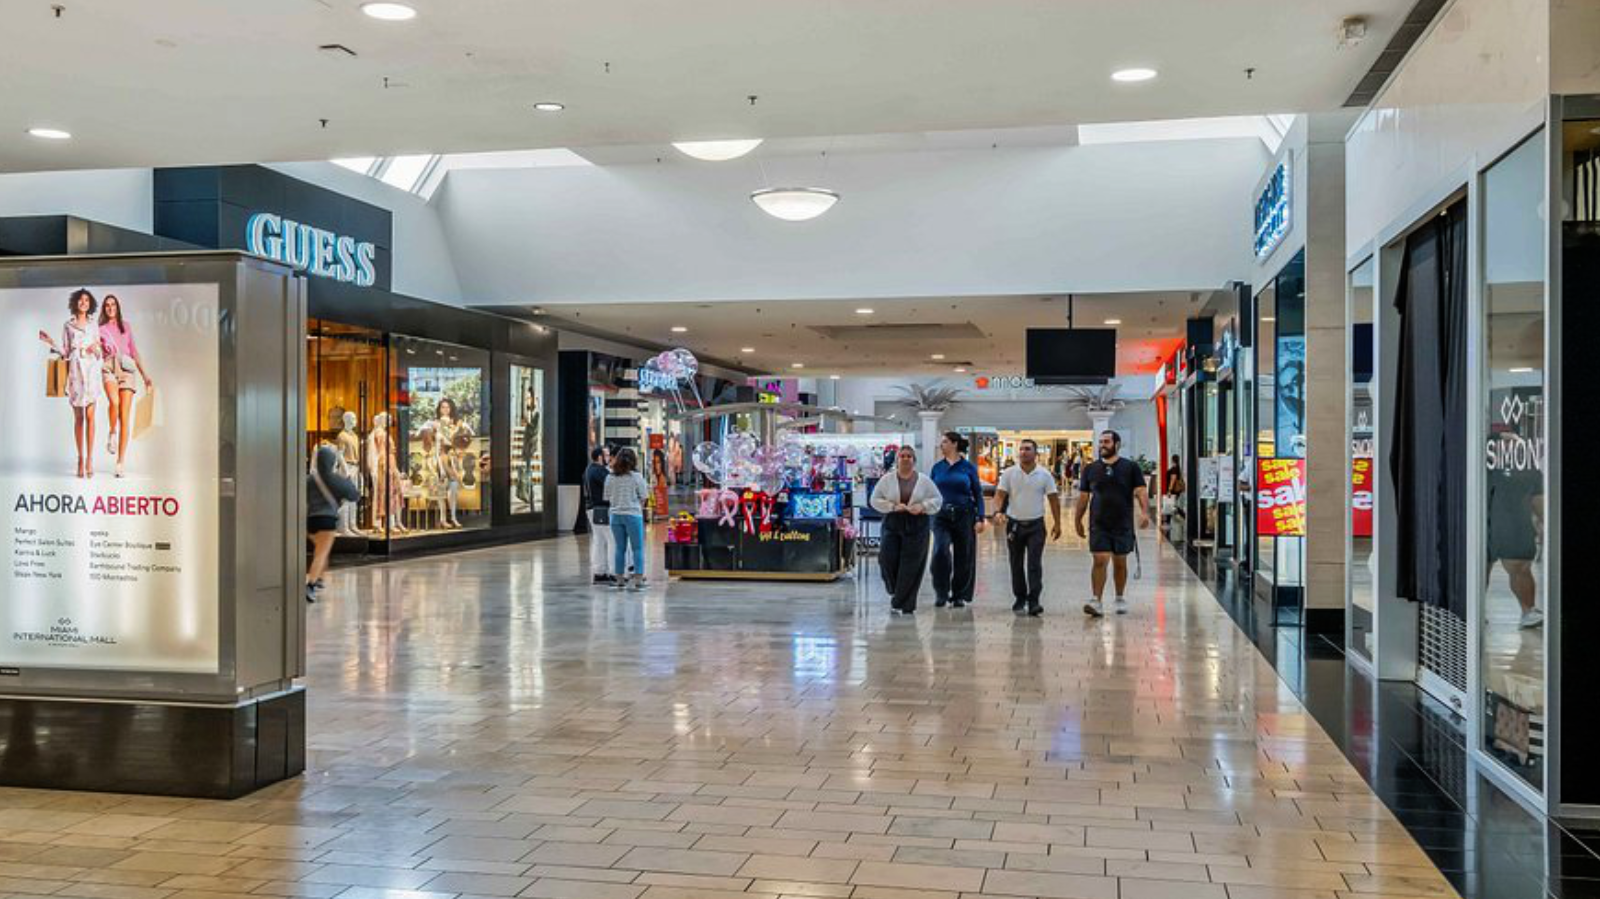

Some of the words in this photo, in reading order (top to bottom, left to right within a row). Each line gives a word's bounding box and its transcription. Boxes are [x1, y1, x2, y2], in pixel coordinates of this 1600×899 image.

[246, 212, 376, 287] GUESS
[1486, 439, 1541, 471] SIMON
[14, 494, 88, 514] AHORA
[92, 496, 180, 516] ABIERTO
[13, 632, 88, 644] INTERNATIONAL
[90, 635, 117, 644] MALL
[50, 626, 79, 634] MIAMI
